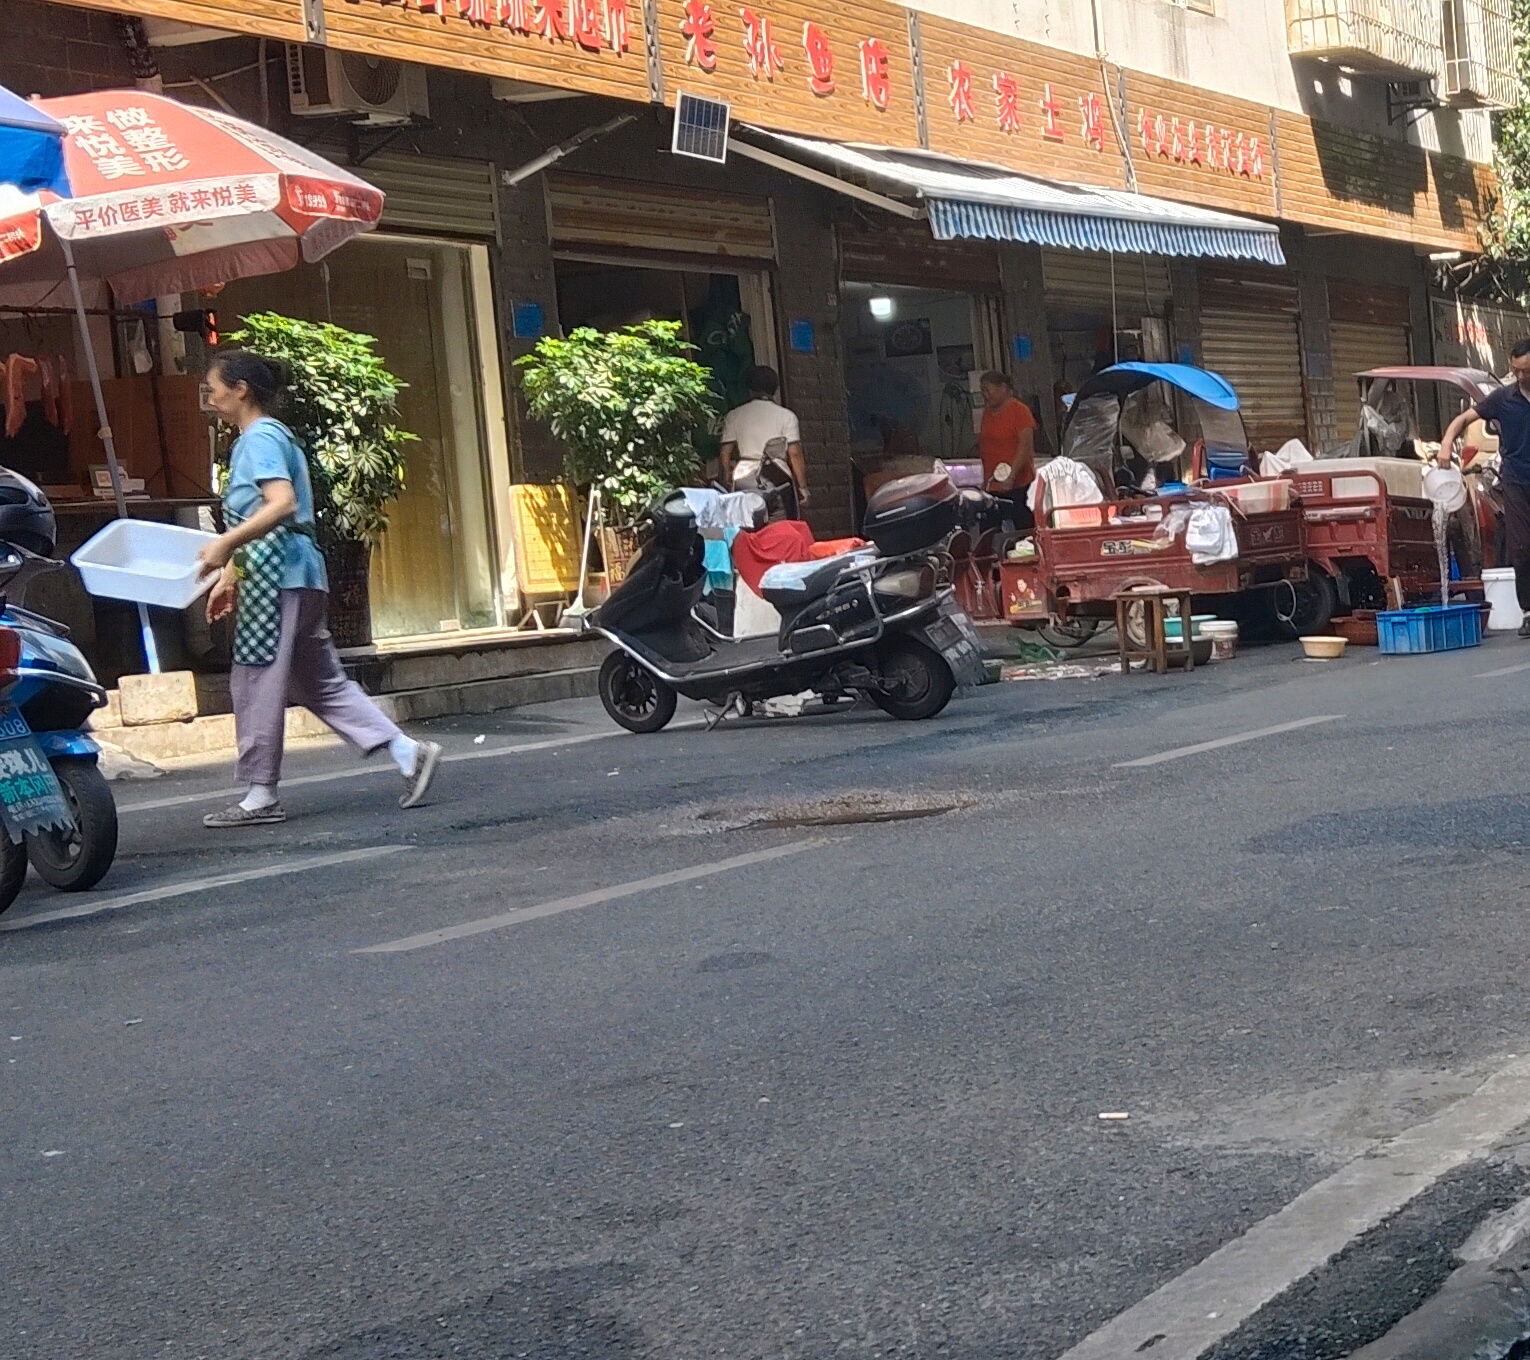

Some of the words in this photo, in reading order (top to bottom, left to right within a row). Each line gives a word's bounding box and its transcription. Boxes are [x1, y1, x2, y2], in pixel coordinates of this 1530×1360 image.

[107, 105, 191, 174] 做整形
[947, 59, 1106, 152] 农家土鸡
[63, 114, 148, 181] 来悦美
[75, 196, 165, 230] 平价医美
[168, 183, 258, 213] 就来悦美
